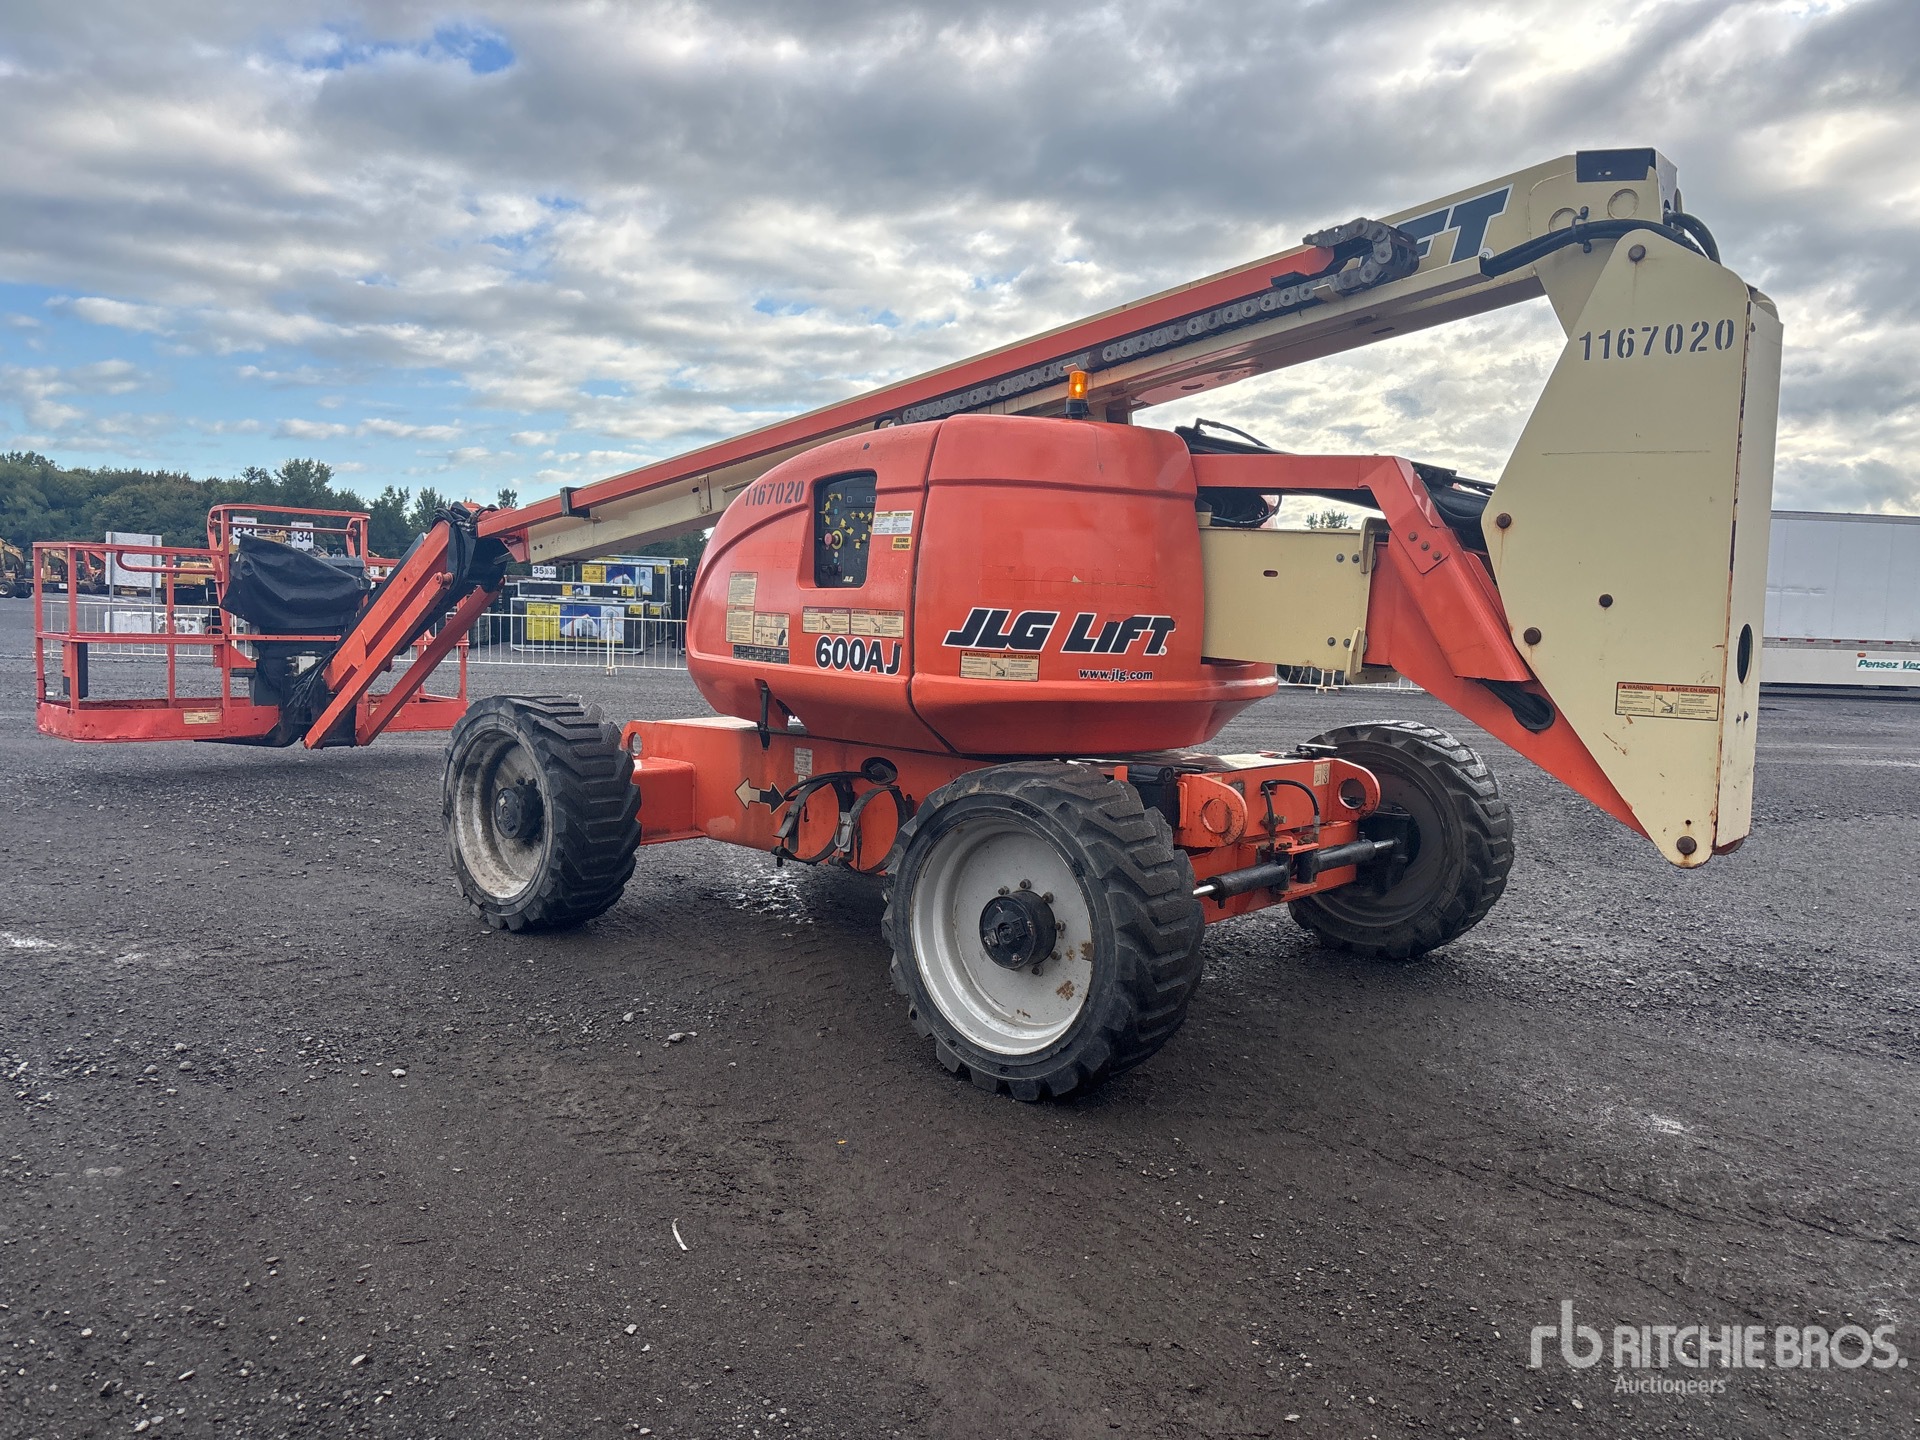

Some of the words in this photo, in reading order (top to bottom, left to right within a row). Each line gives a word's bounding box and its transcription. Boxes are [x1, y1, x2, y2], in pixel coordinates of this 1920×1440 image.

[1389, 183, 1514, 264] FT
[1579, 319, 1735, 361] 1167020
[745, 480, 805, 506] 1167020
[298, 531, 312, 542] 34
[533, 566, 545, 575] 35
[942, 607, 1060, 653] JLG
[1060, 612, 1177, 656] LIFT
[815, 635, 902, 676] 600AJ
[1858, 660, 1899, 668] Pensez
[1078, 668, 1153, 682] www.jlg.com
